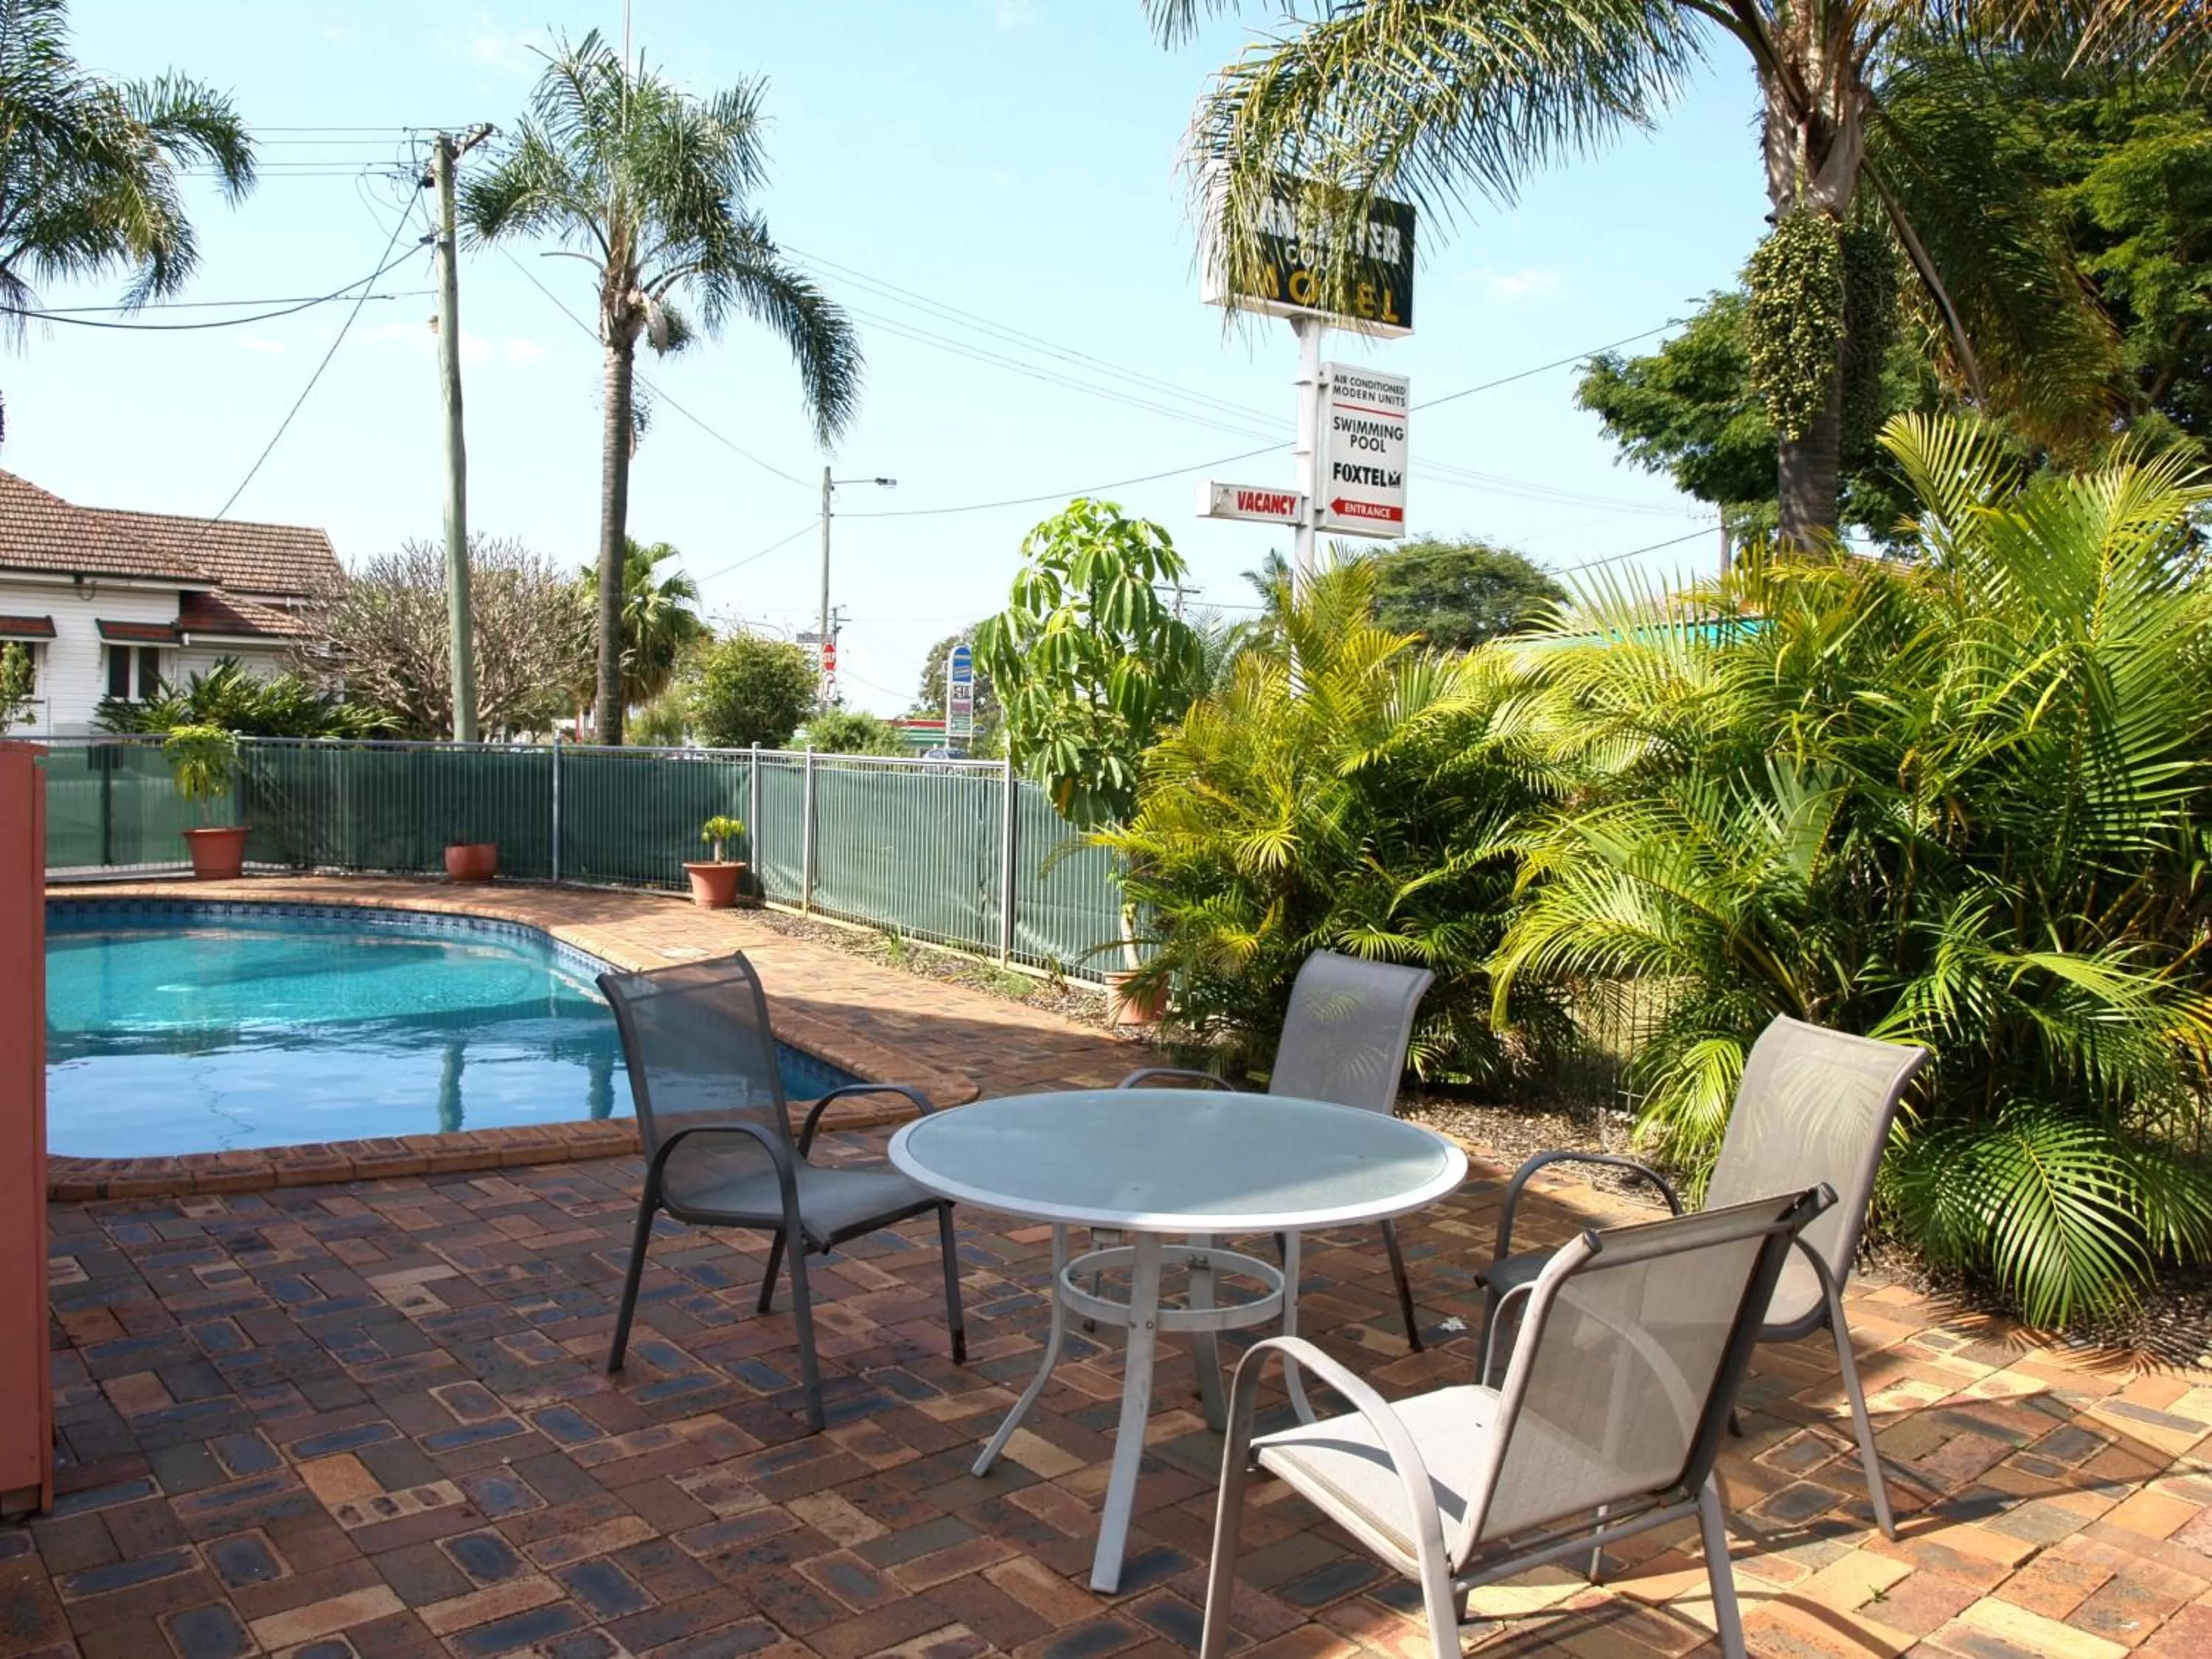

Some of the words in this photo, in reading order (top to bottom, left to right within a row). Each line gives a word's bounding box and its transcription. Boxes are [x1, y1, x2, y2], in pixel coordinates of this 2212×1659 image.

[1243, 262, 1399, 323] MOEL
[1333, 384, 1376, 402] MODERN
[1378, 392, 1405, 407] UNITS
[1334, 374, 1347, 384] AIR
[1350, 377, 1405, 395] CONDITIONED
[1333, 415, 1404, 441] SWIMMING
[1350, 434, 1386, 453] POOL
[1332, 461, 1387, 487] FOXTEL
[1238, 490, 1296, 515] VACANCY
[1344, 502, 1391, 518] ENTRANCE
